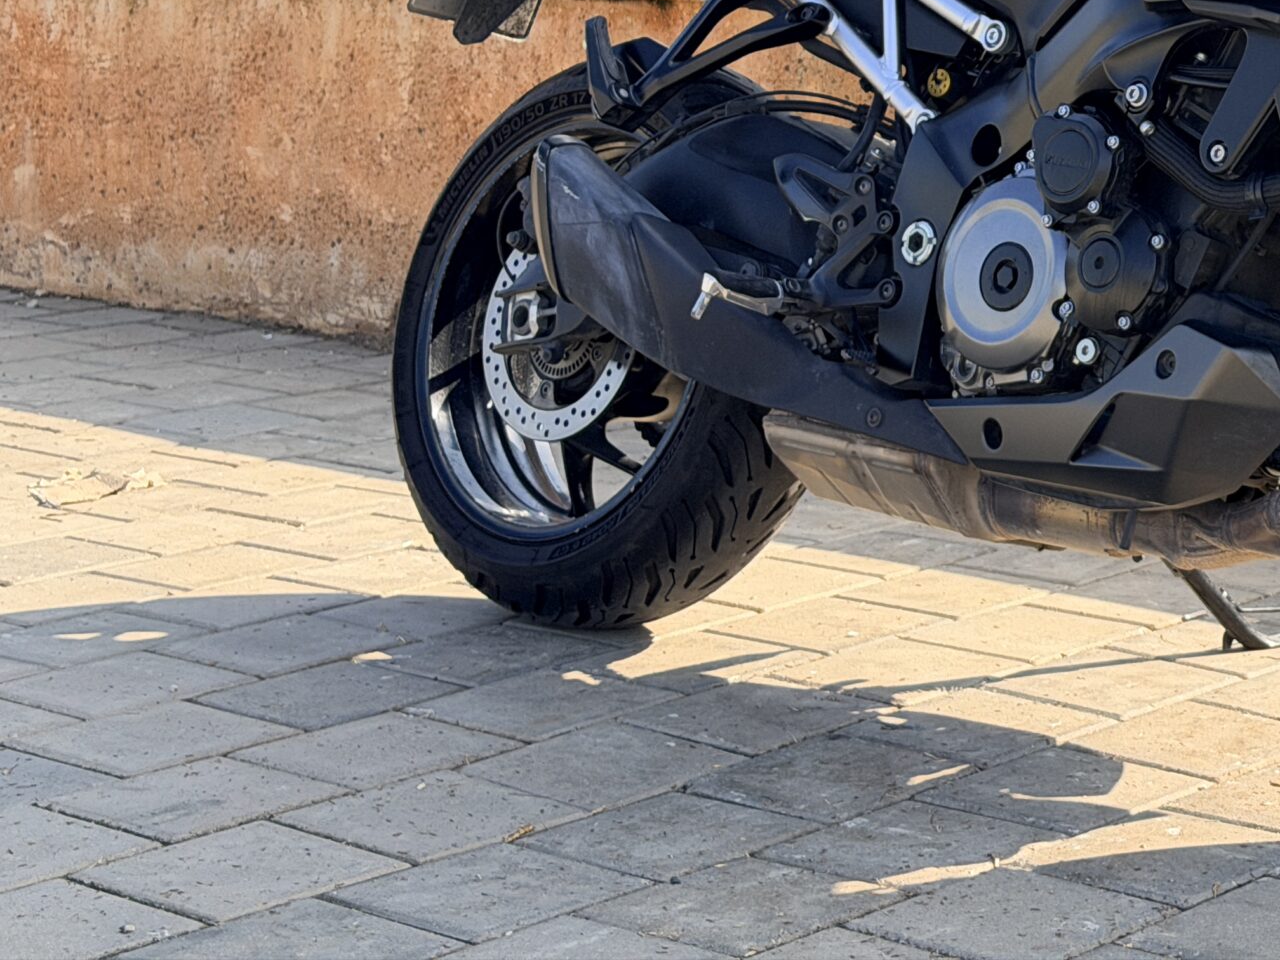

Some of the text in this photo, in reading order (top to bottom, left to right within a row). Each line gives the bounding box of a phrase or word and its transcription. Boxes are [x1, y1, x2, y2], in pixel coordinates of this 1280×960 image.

[438, 91, 587, 217] MICHELIN 190/50 ZR 17
